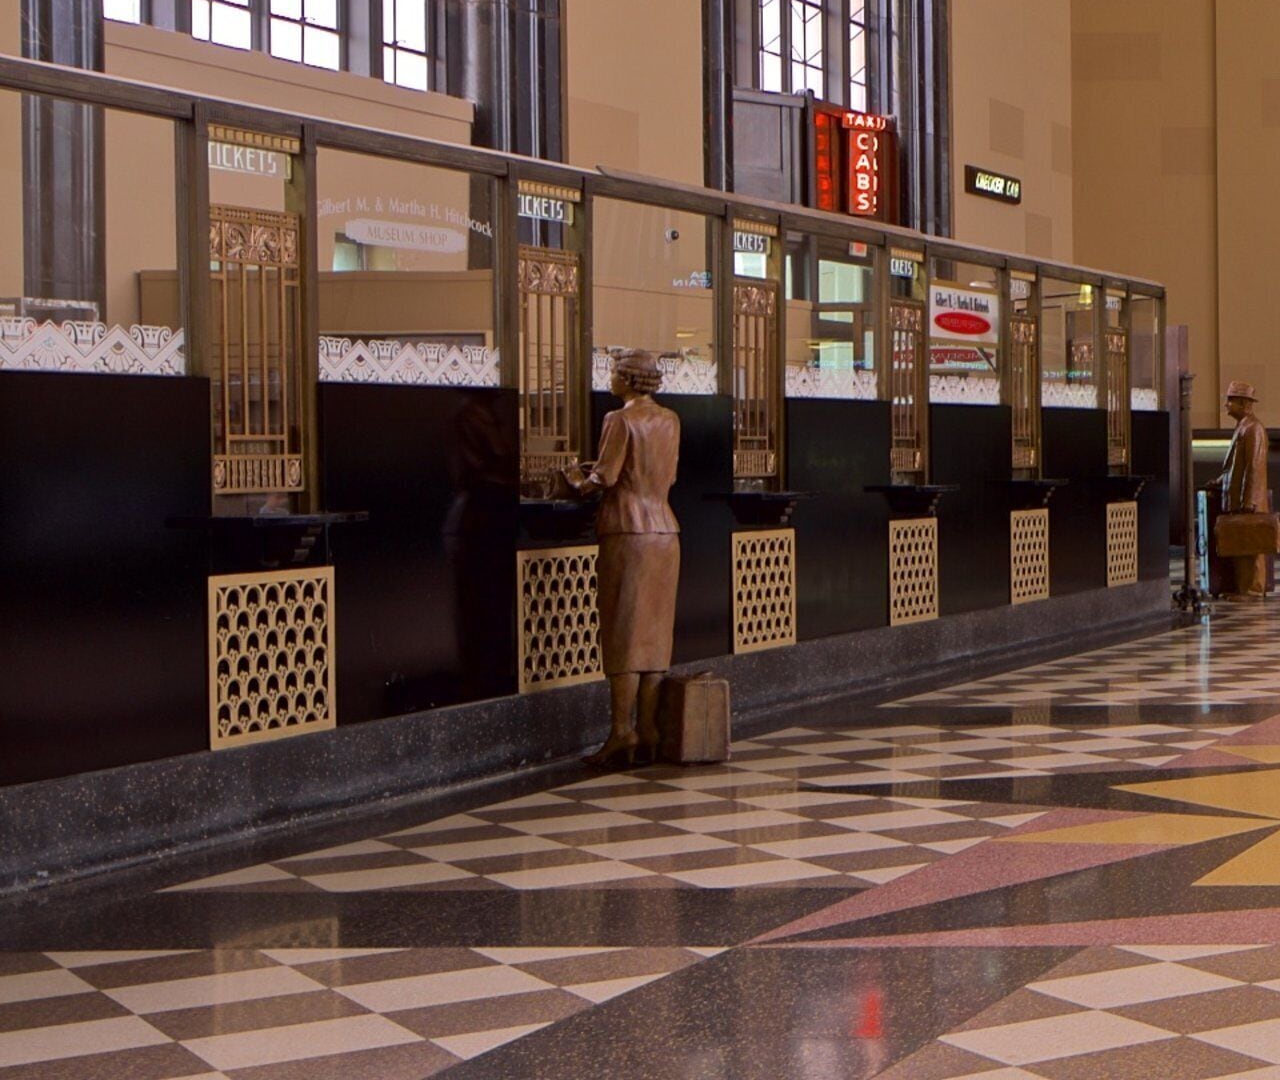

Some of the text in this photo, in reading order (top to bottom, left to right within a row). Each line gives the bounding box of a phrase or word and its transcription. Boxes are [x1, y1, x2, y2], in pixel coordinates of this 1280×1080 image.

[855, 133, 871, 211] CABS
[388, 197, 426, 217] Martha
[445, 205, 493, 239] Hitchcock
[517, 193, 564, 220] ICKETS
[366, 223, 448, 247] MUSEUM SHOP
[734, 231, 764, 252] ICKETS
[891, 258, 913, 275] CKETS
